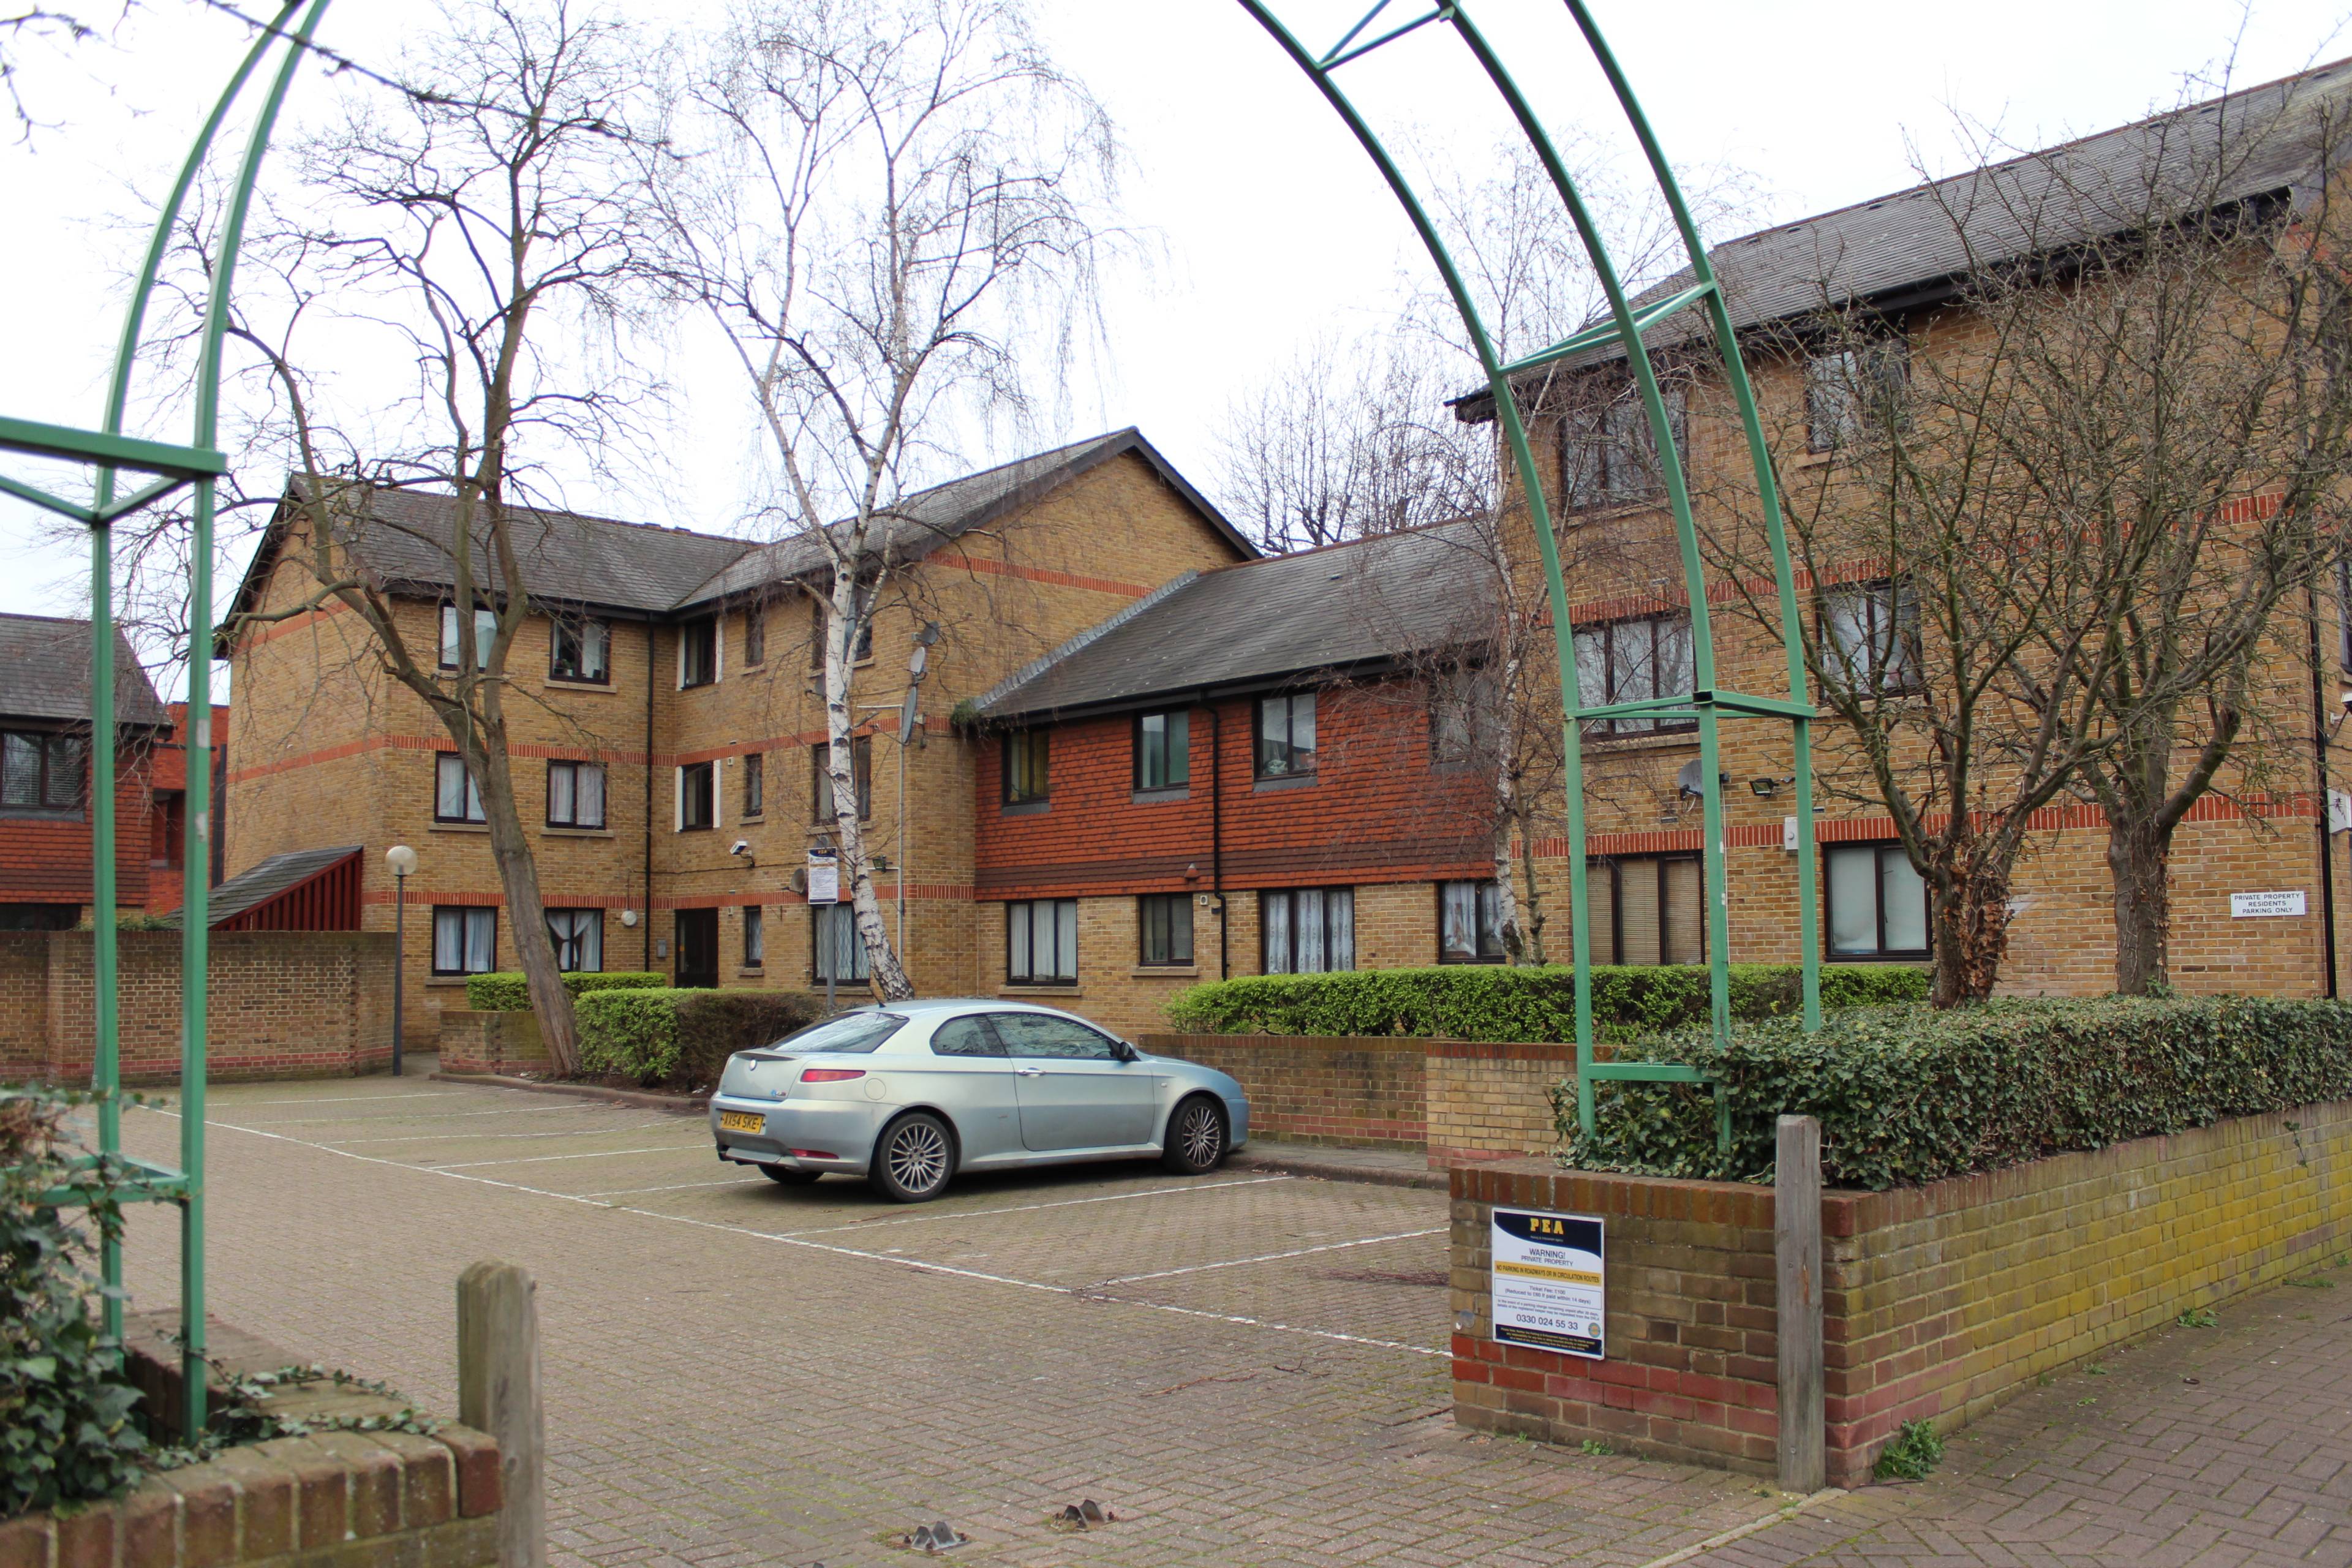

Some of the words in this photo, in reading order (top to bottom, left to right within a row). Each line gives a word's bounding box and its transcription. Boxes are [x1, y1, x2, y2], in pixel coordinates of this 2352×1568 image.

[724, 1114, 741, 1127] AX54
[742, 1116, 758, 1129] SKE
[1530, 1218, 1564, 1234] PEA
[1529, 1248, 1566, 1259] WARNING!
[1544, 1257, 1574, 1266] PROPERTY
[1558, 1272, 1583, 1280] CIRCULATION
[1584, 1275, 1599, 1283] ROUTES
[1517, 1314, 1536, 1324] 0330
[1538, 1317, 1553, 1326] 024
[1556, 1319, 1566, 1328] 55
[1568, 1321, 1578, 1330] 33
